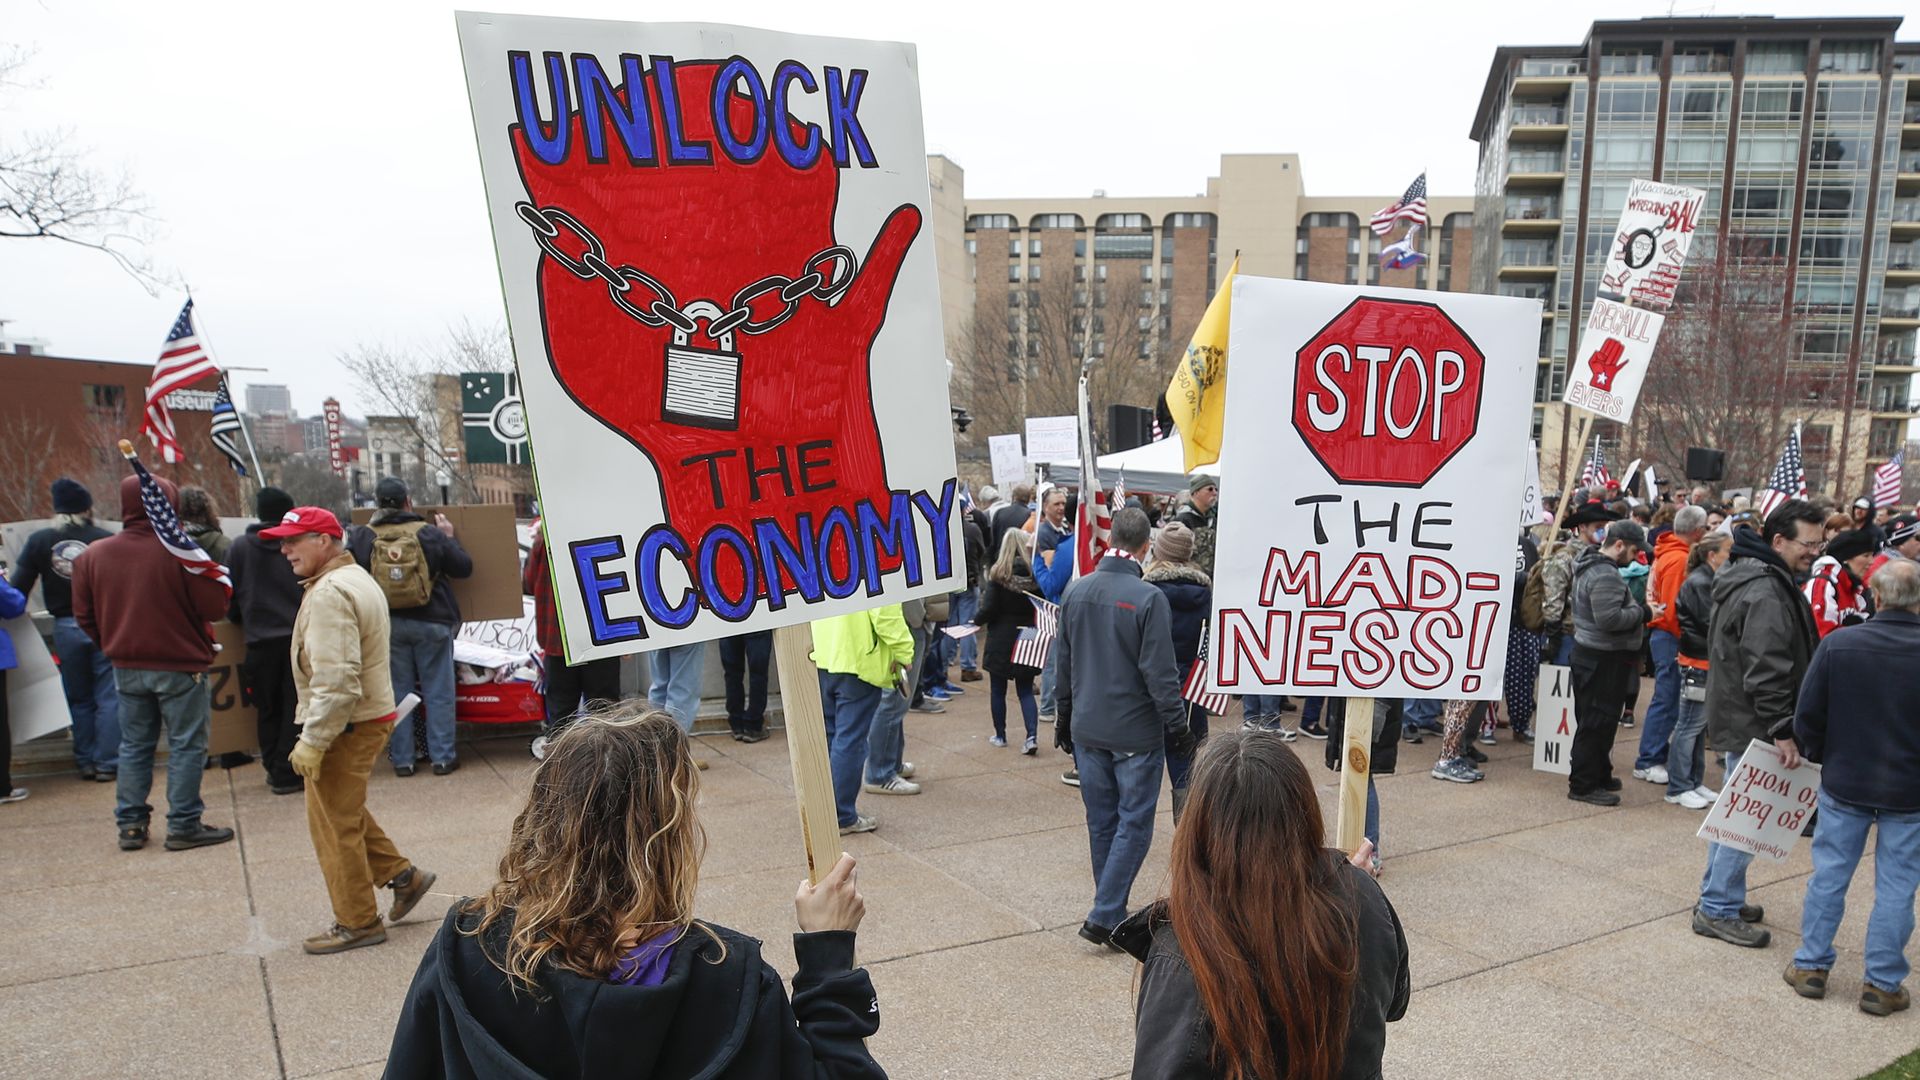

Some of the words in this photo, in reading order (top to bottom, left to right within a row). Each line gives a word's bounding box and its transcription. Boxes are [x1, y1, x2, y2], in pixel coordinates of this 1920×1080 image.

[507, 50, 879, 169] UNLOCK
[1665, 195, 1702, 233] BALL
[1589, 300, 1650, 343] RECALL
[1306, 343, 1465, 442] STOP
[1569, 381, 1624, 417] EVERS
[681, 440, 836, 509] THE
[1295, 494, 1453, 551] THE
[568, 477, 957, 646] ECONOMY
[1258, 547, 1500, 611] MAD-
[1217, 601, 1500, 693] NESS!
[1731, 763, 1791, 797] work!
[1798, 787, 1818, 809] to
[1724, 791, 1773, 830] back
[1777, 808, 1806, 831] go
